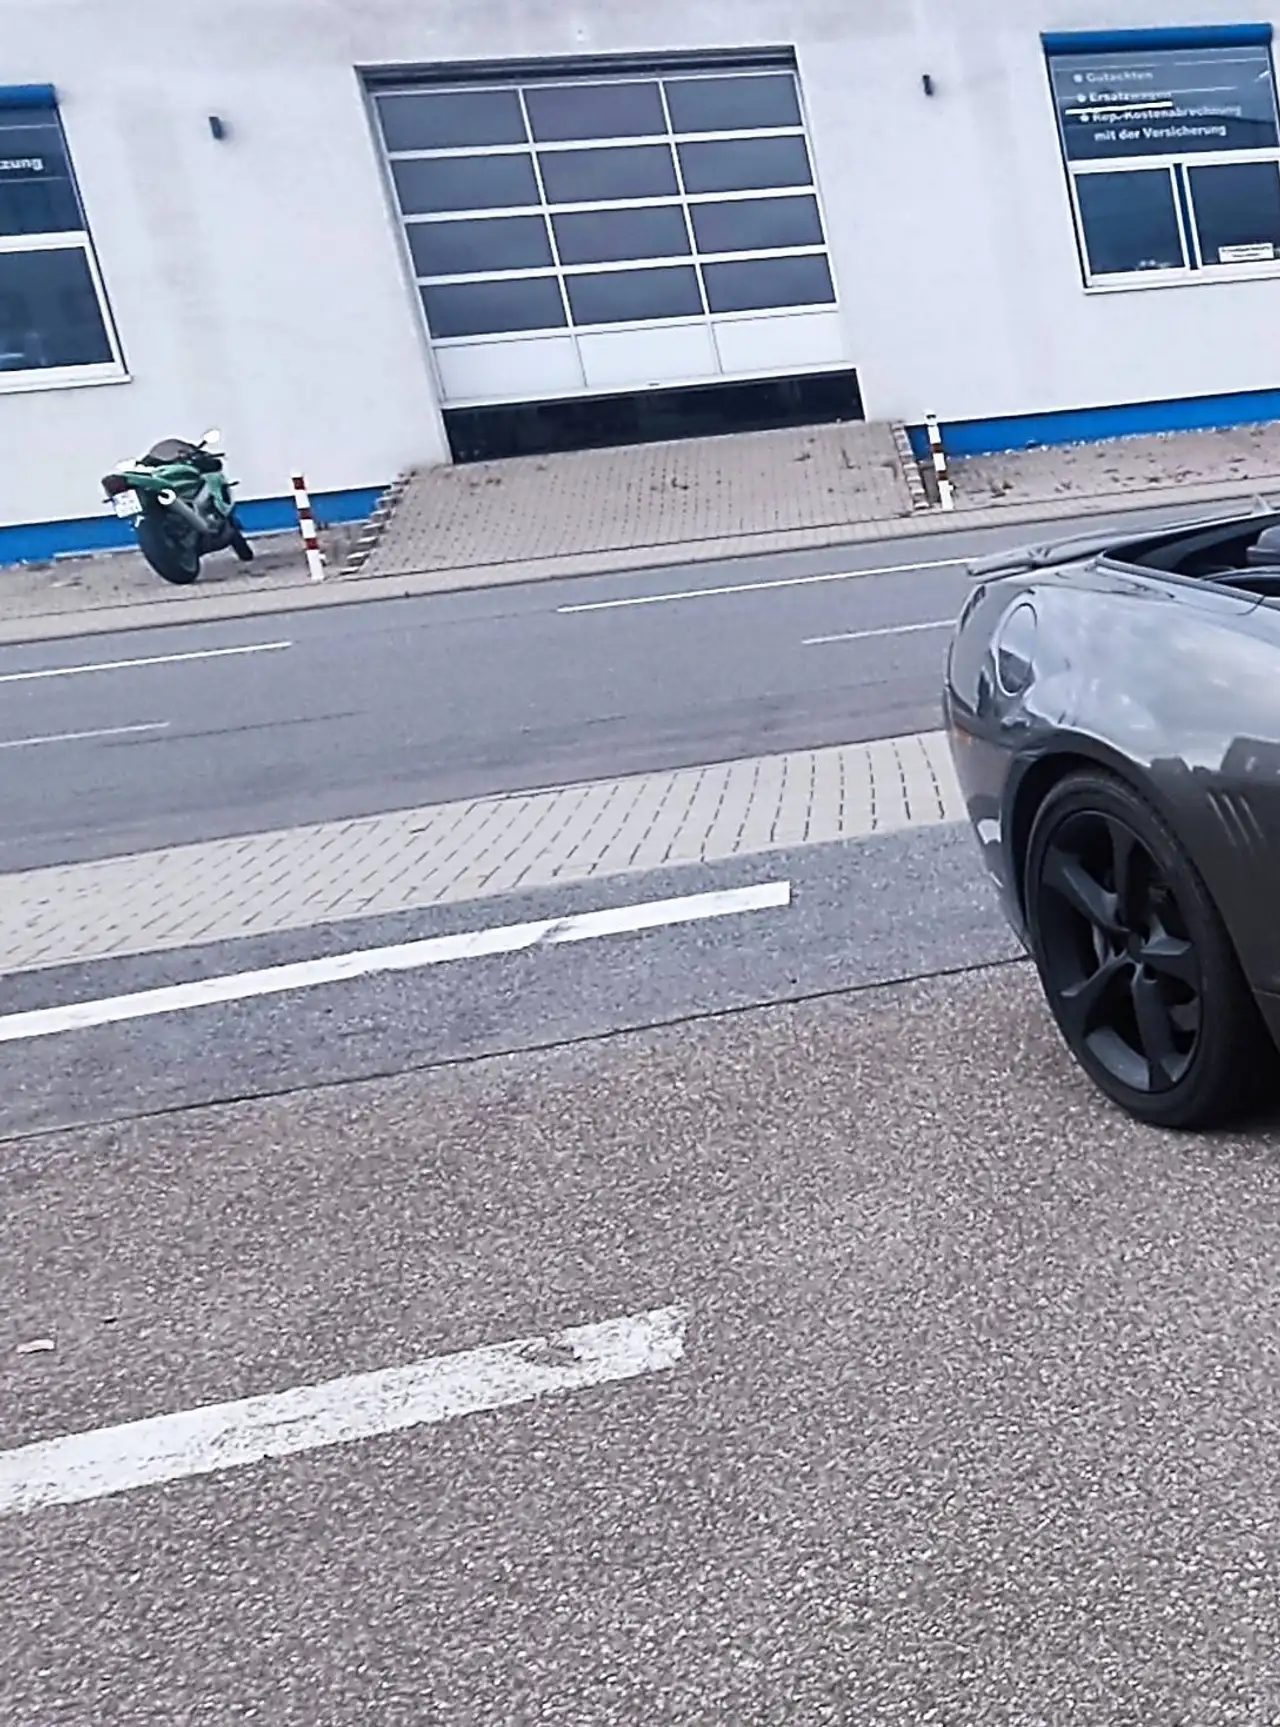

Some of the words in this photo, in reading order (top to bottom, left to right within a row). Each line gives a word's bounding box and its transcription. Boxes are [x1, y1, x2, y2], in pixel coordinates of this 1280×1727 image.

[1085, 72, 1153, 83] Gutachten
[1094, 130, 1116, 141] mit
[1119, 129, 1140, 140] der
[1142, 125, 1227, 138] Versicherung
